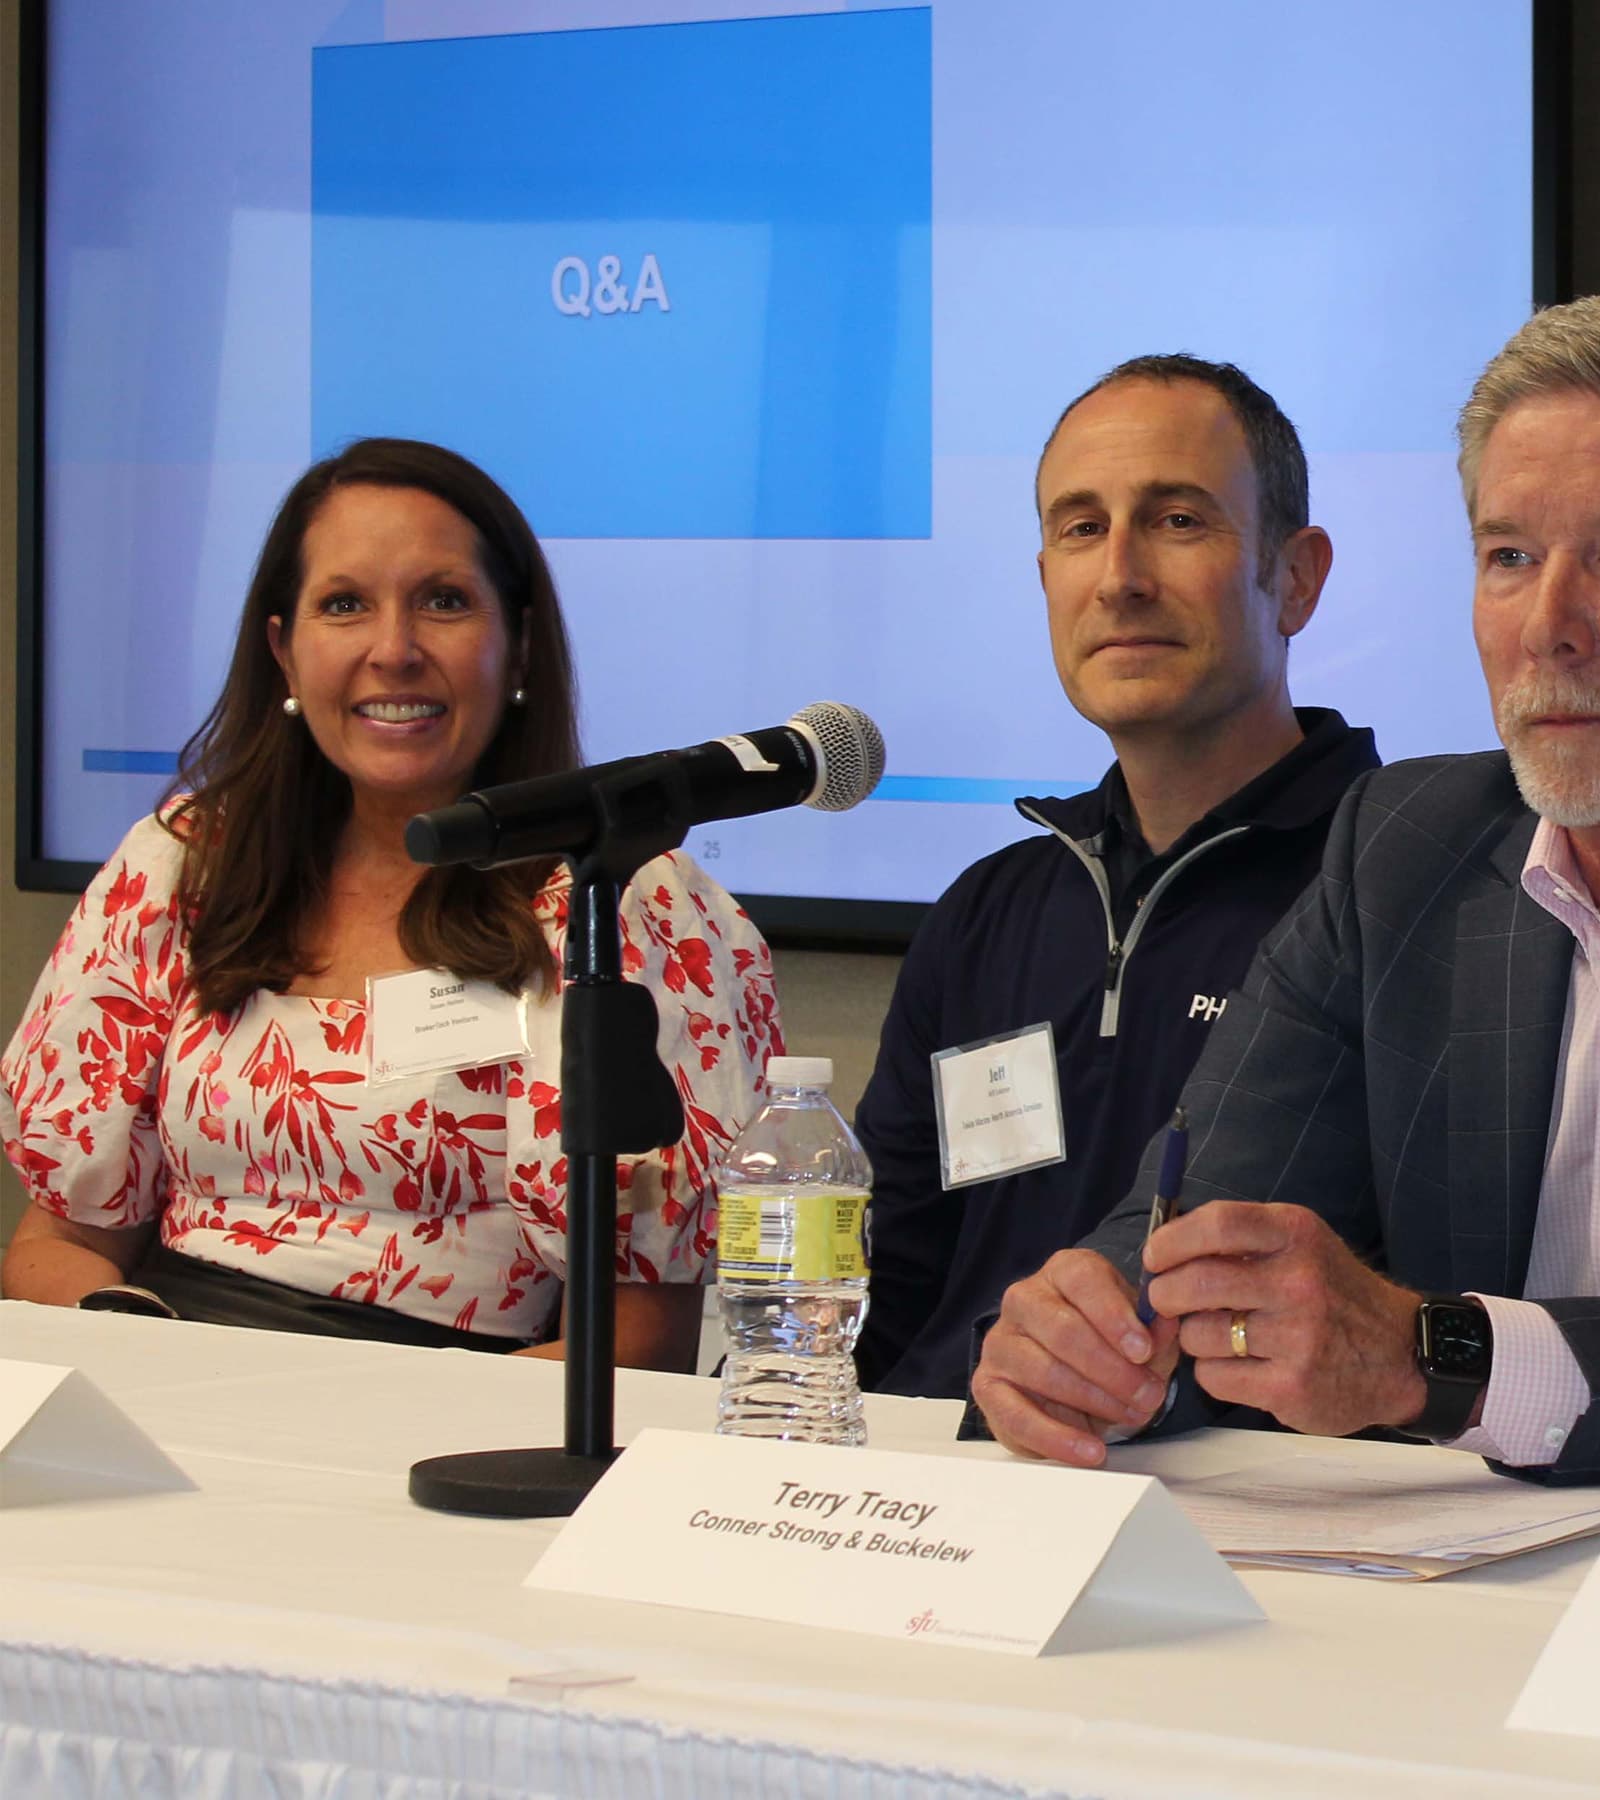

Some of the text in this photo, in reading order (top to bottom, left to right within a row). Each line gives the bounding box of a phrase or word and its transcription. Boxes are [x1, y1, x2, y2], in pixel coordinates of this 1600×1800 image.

[551, 254, 671, 318] Q&A
[703, 841, 721, 860] 25
[430, 983, 465, 999] Susan
[1188, 994, 1228, 1022] PH
[989, 1065, 1006, 1084] Jeff
[773, 1481, 939, 1530] Terry Tracy
[688, 1509, 975, 1563] Conner Strong & Buckelew
